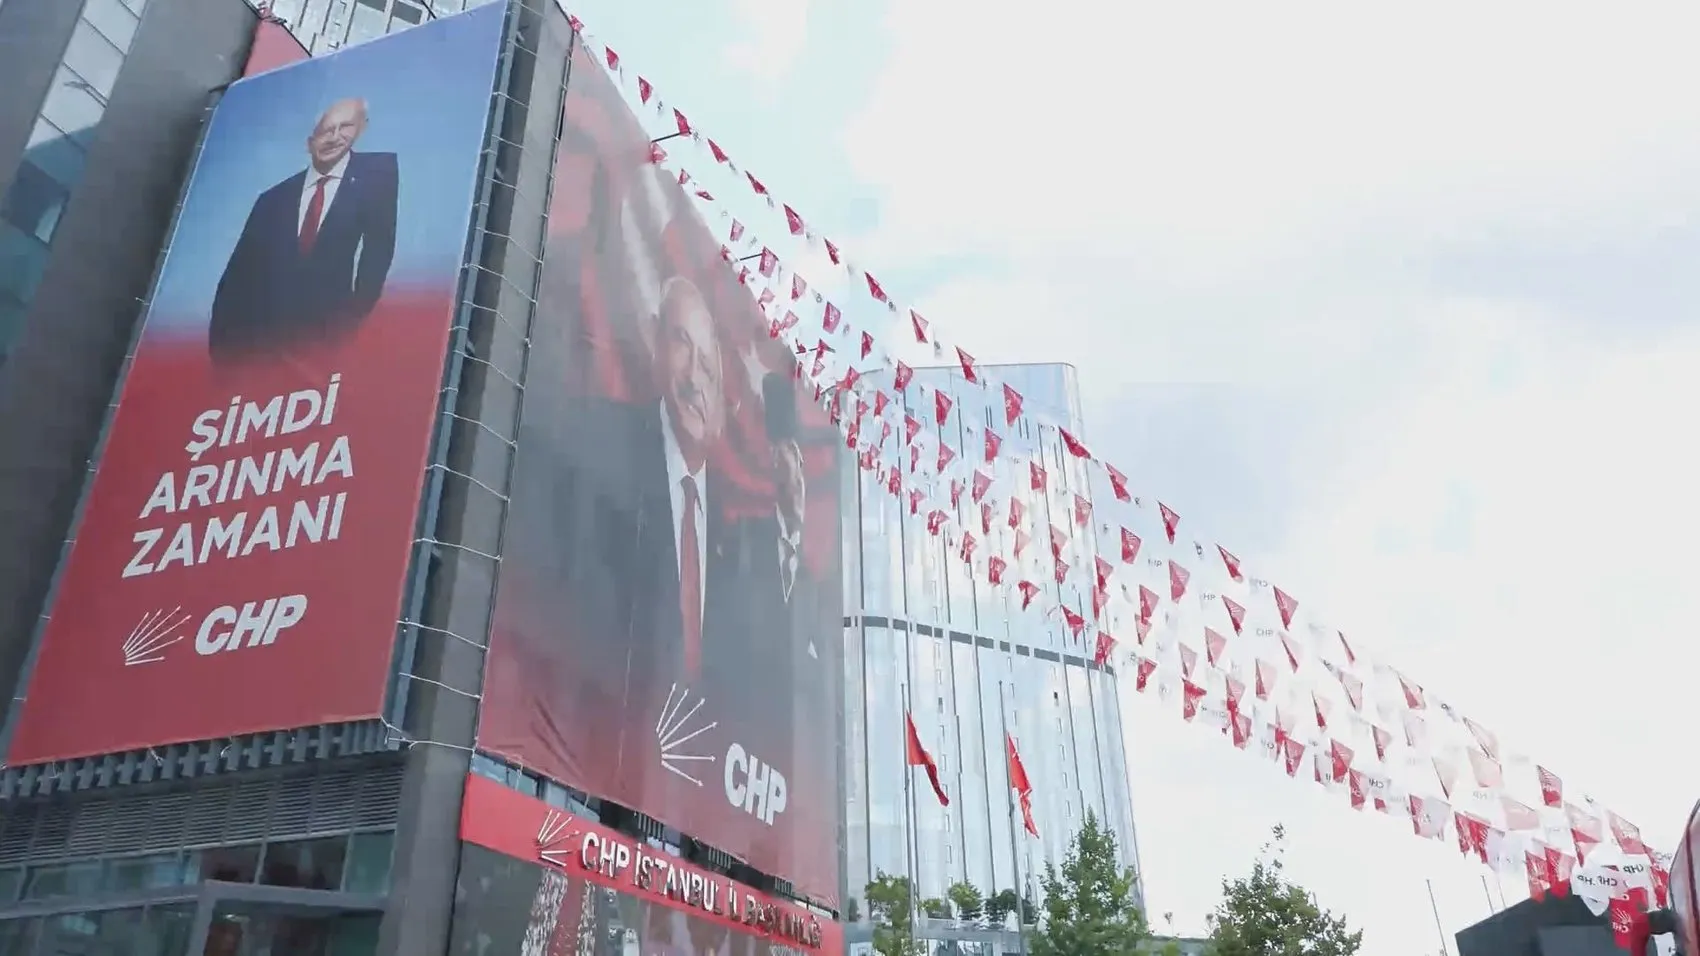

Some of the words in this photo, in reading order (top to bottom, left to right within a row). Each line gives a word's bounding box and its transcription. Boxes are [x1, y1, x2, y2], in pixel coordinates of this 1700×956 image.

[185, 373, 341, 461] ŞİMDİ
[139, 435, 354, 519] ARINMA
[121, 491, 347, 578] ZAMANI
[195, 594, 307, 655] CHP
[724, 742, 787, 826] CHP
[582, 831, 631, 879] CHP
[634, 842, 724, 916] İSTANBUL
